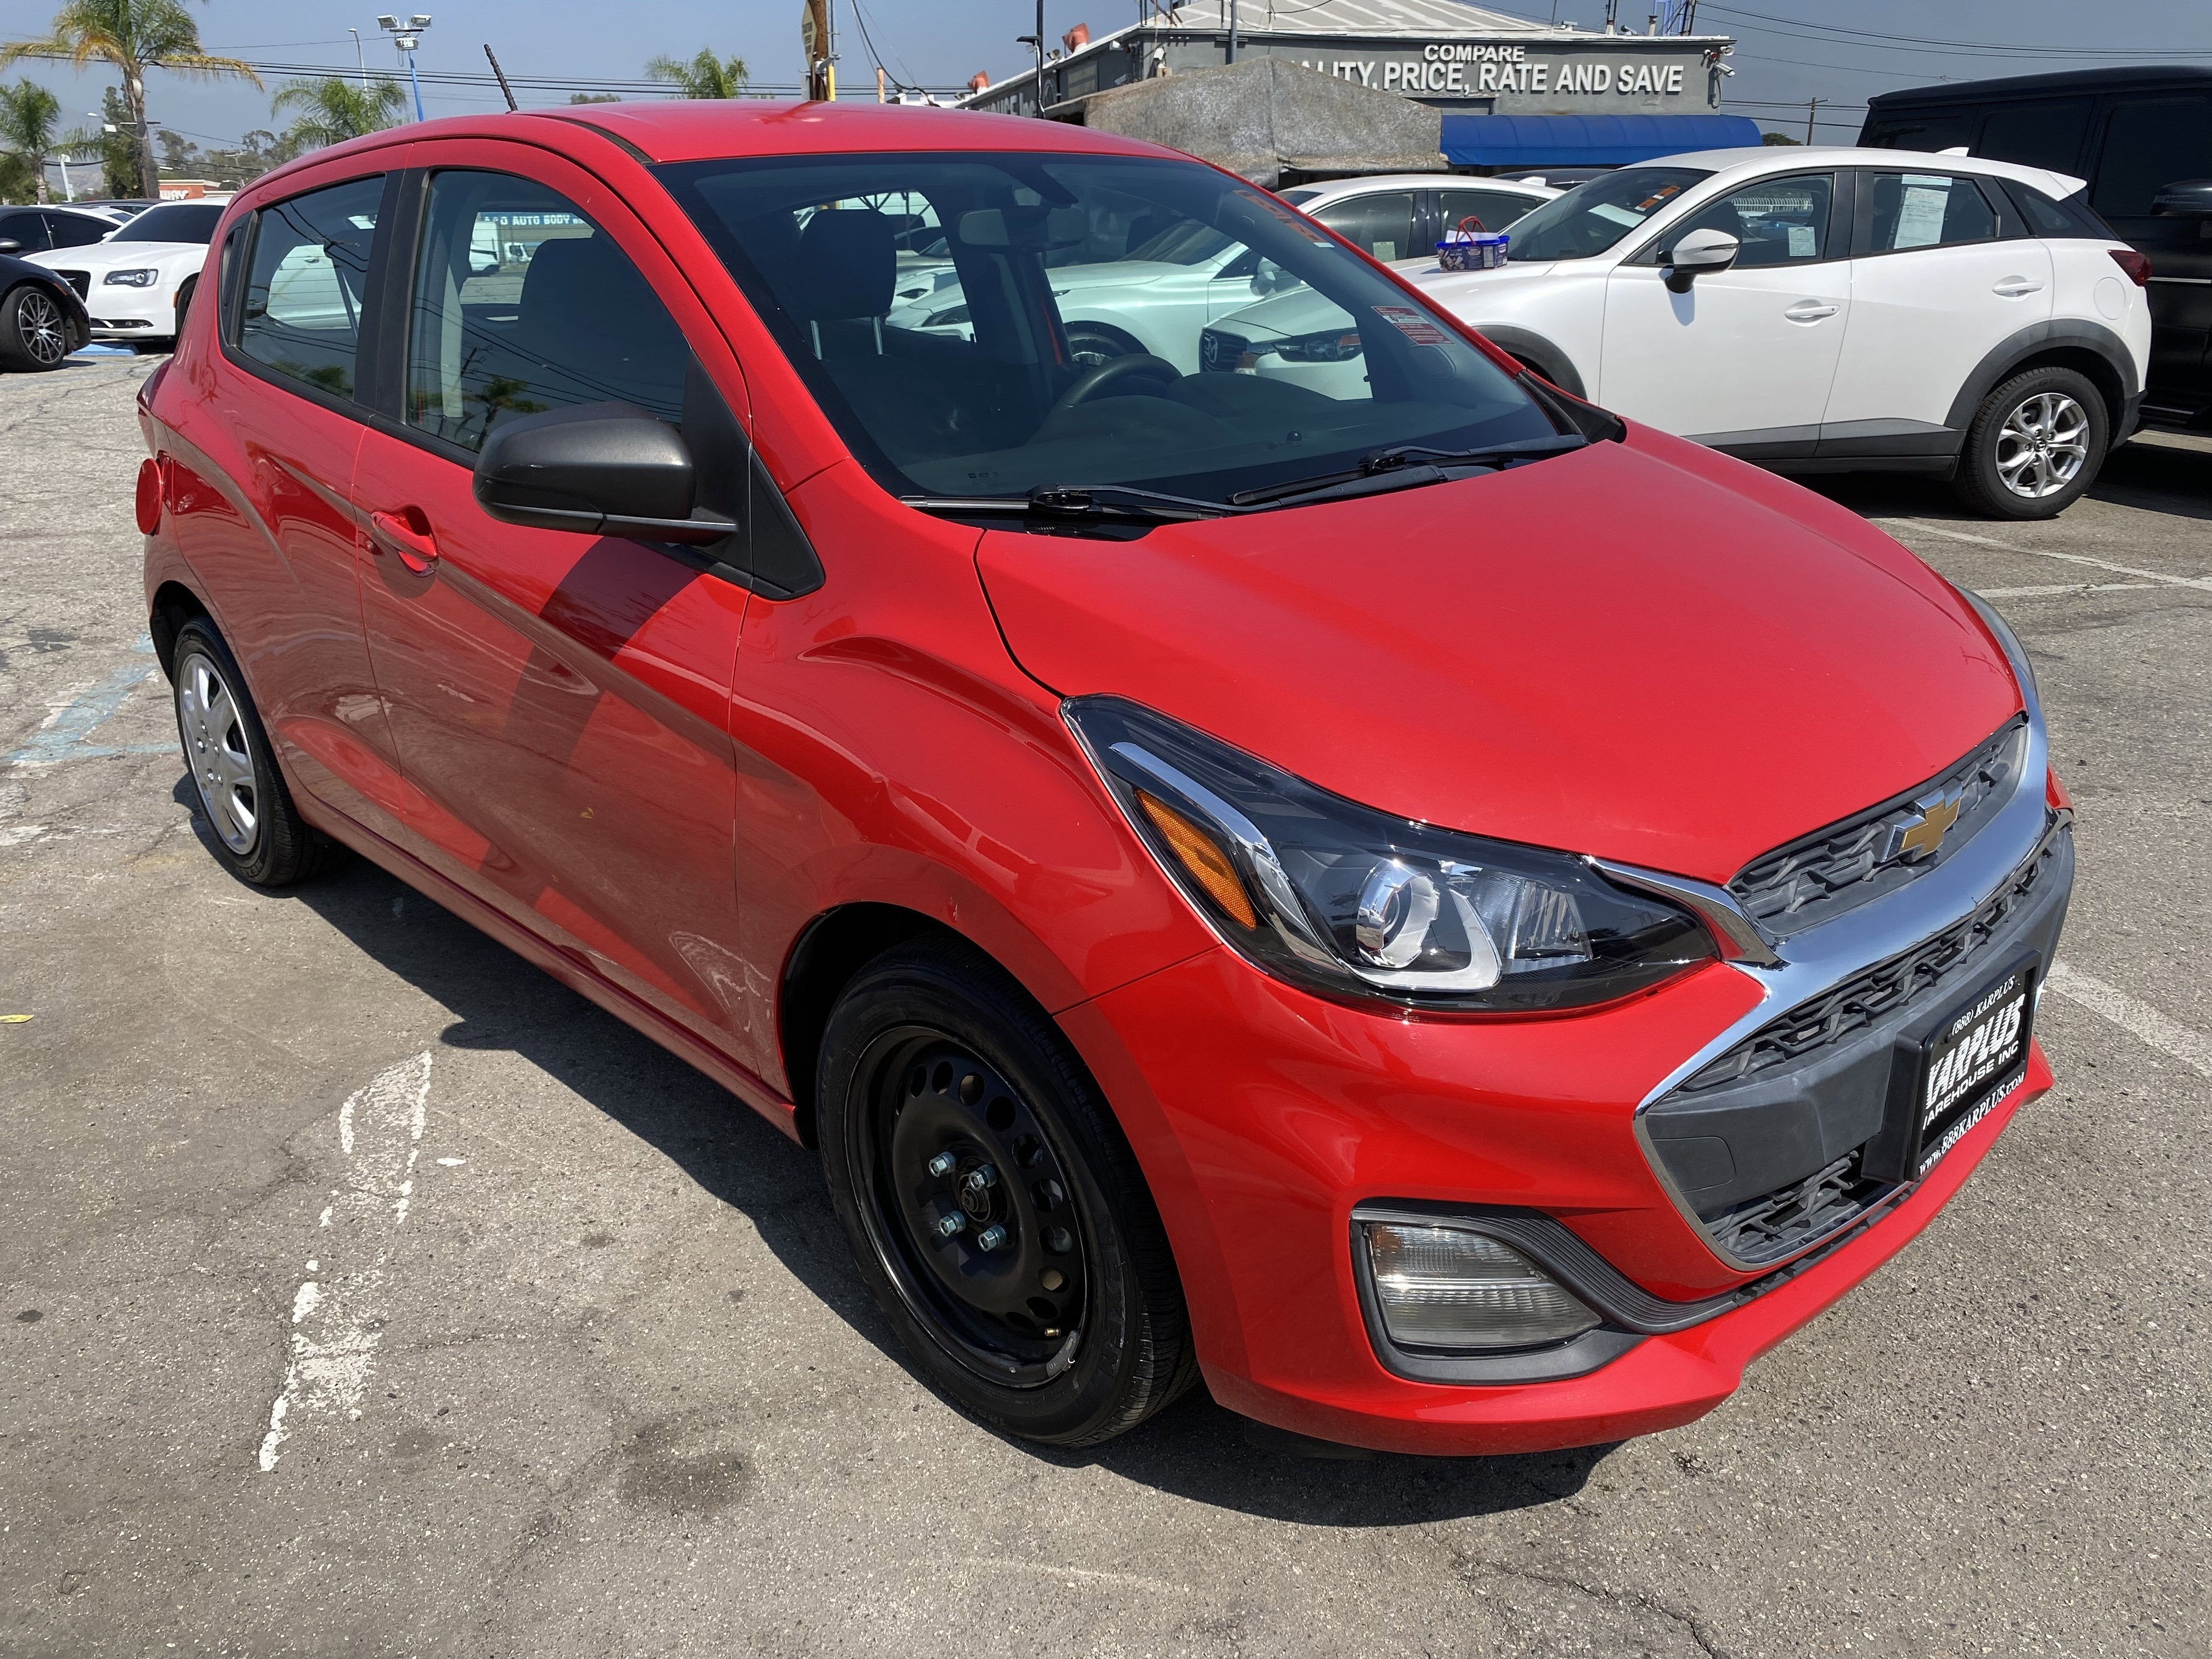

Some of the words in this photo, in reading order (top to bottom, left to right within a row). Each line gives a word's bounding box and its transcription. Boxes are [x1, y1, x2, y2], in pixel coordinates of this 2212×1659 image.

[1424, 44, 1525, 61] COMPARE
[1384, 61, 1470, 95] PRICE,
[1479, 63, 1548, 91] RATE
[1555, 64, 1612, 91] AND
[1618, 65, 1684, 92] SAVE
[512, 215, 540, 226] AUTO
[543, 215, 570, 224] BODY
[1951, 1009, 1974, 1036] (888)
[1973, 975, 2016, 1019] KARPLUS
[1922, 1059, 1995, 1131] AREHOUSE
[1998, 1040, 2019, 1065] INC
